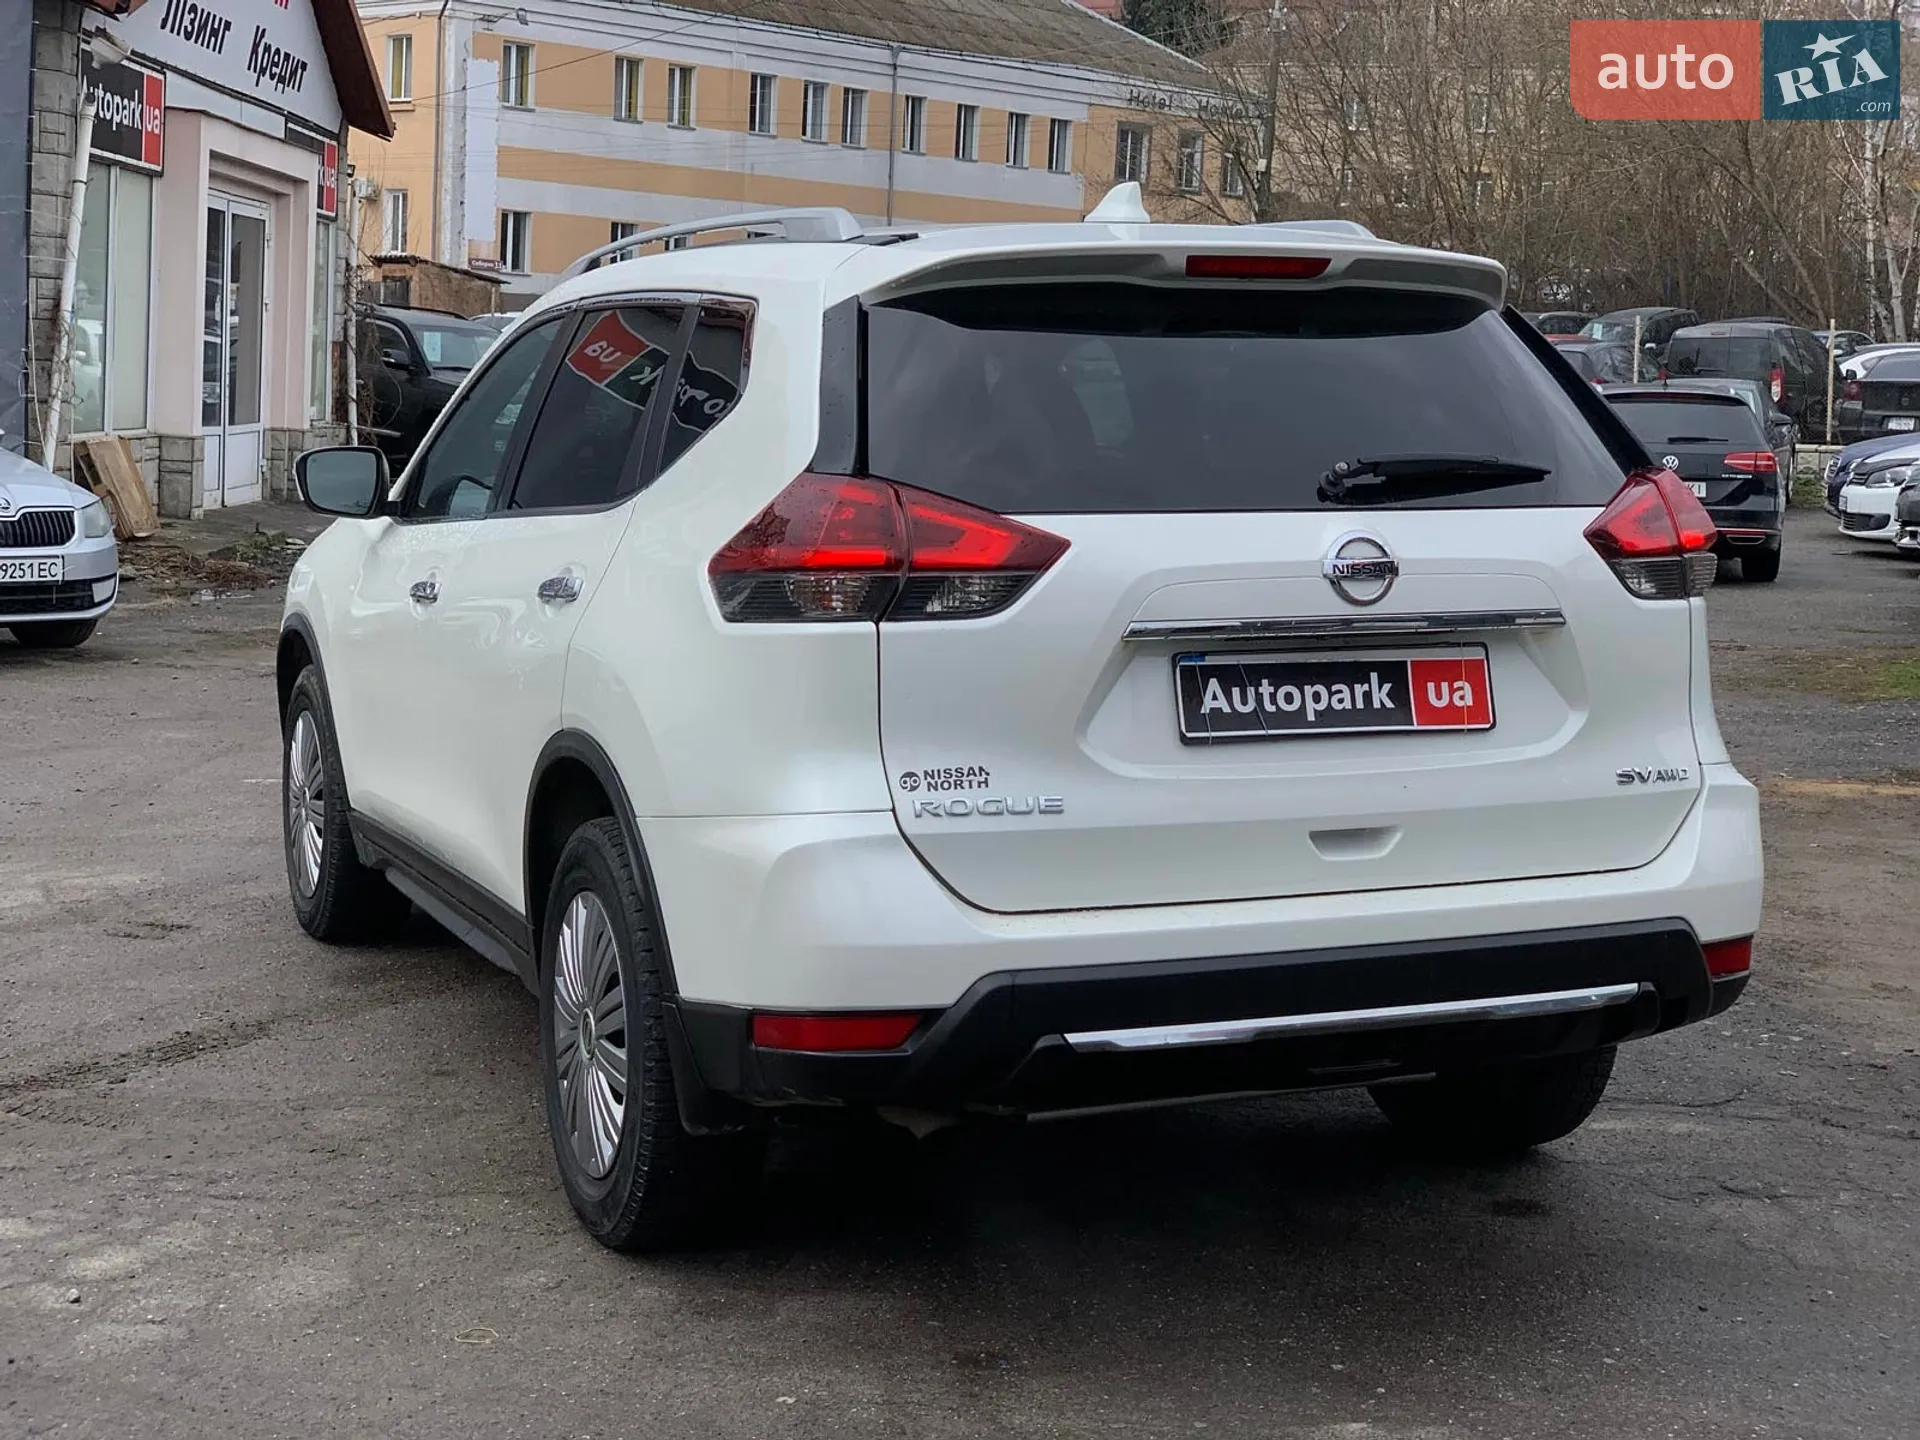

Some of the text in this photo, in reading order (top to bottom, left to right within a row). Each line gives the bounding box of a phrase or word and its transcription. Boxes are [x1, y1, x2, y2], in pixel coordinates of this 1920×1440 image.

[247, 25, 308, 94] Кредит
[1128, 89, 1173, 111] Hotel
[146, 105, 160, 135] ua
[1332, 562, 1393, 575] NISSAN
[1200, 672, 1474, 722] Autopark ua
[923, 766, 990, 781] NISSAN
[926, 777, 989, 792] NORTH
[912, 795, 1065, 818] ROGUE
